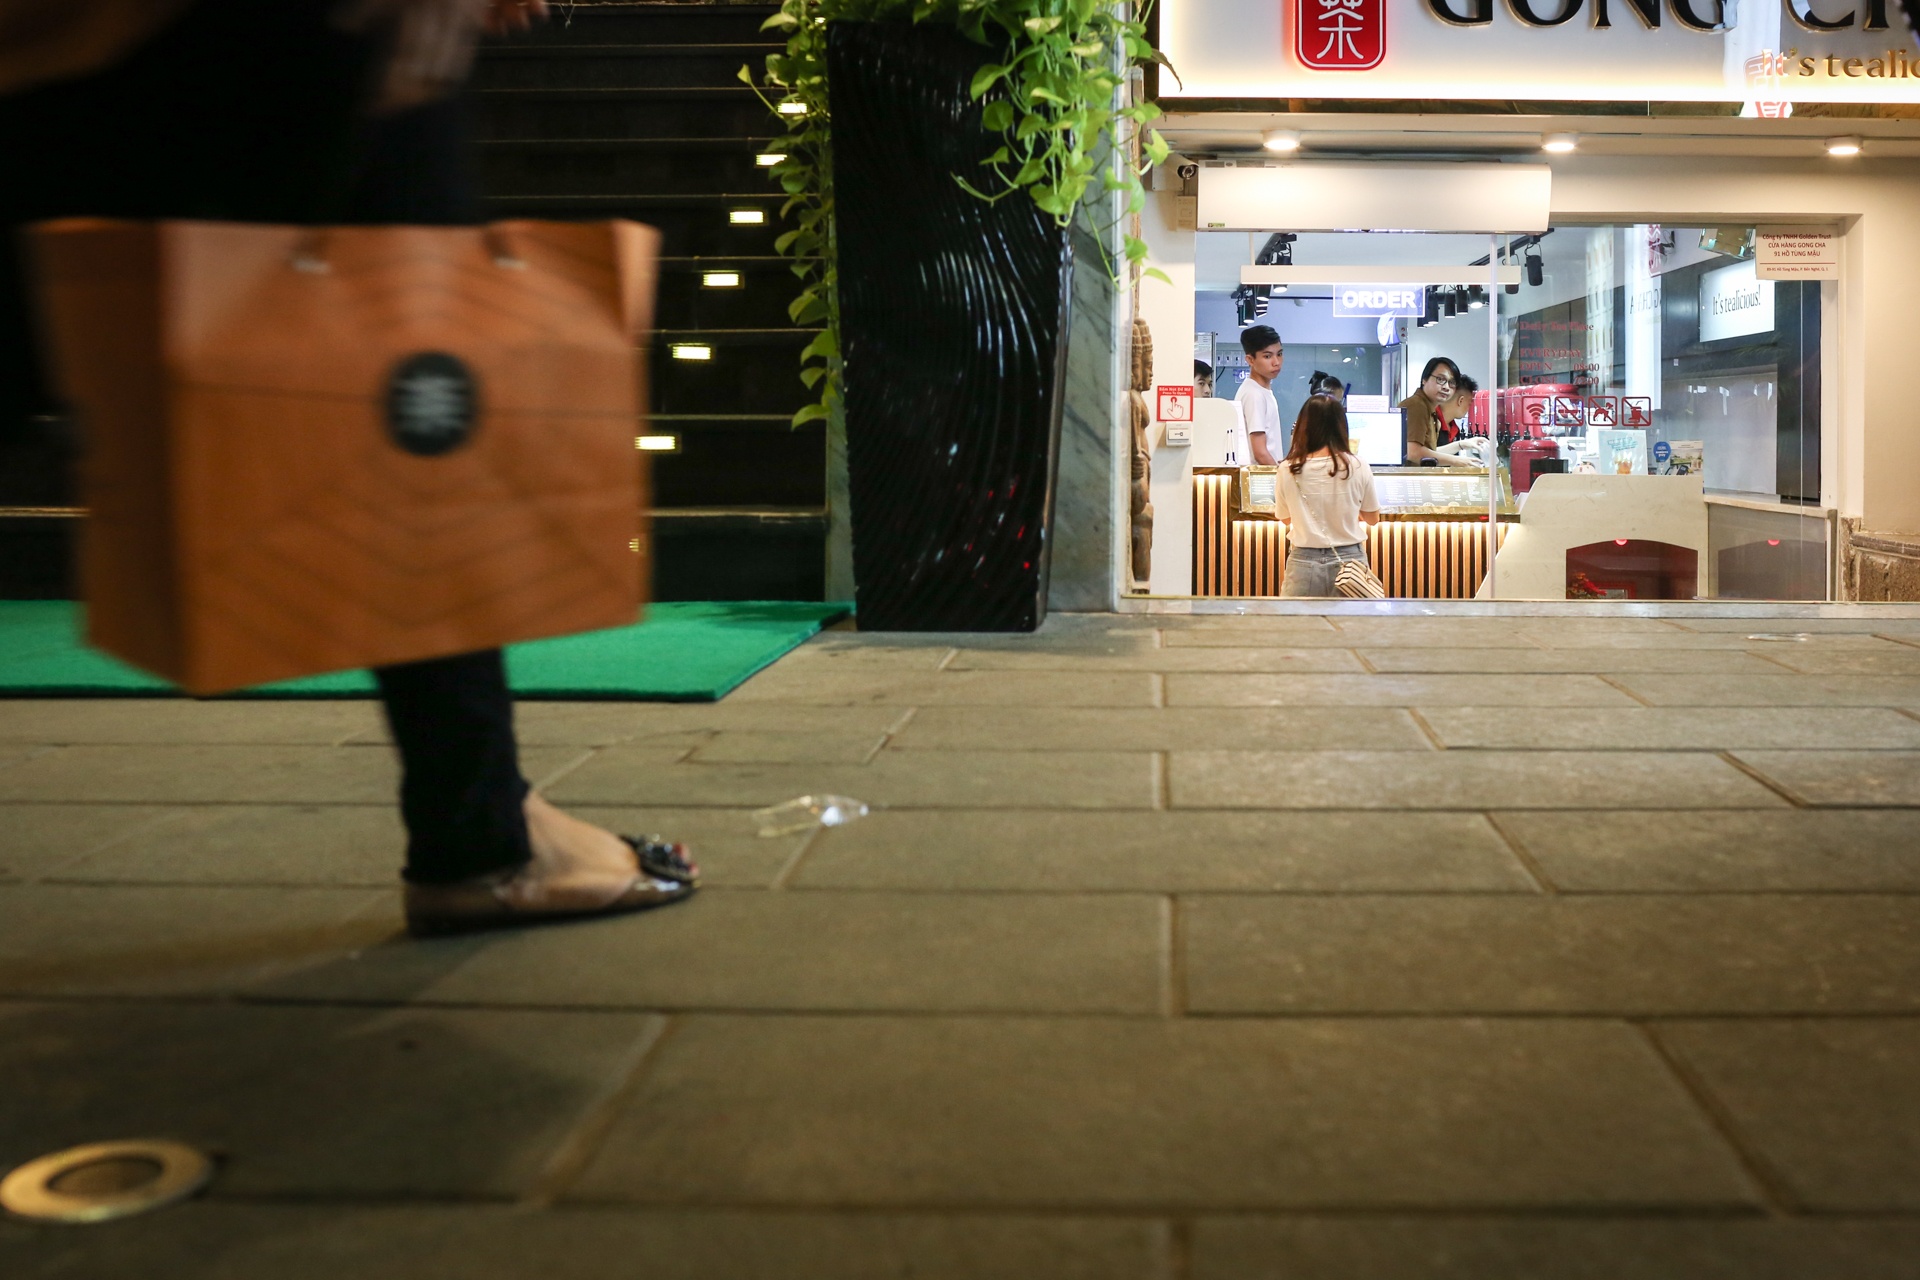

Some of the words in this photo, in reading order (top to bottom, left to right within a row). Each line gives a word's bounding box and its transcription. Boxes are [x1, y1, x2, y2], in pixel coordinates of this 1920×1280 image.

[1781, 249, 1790, 257] HỒ
[1807, 249, 1821, 258] MẬU
[1342, 290, 1417, 309] ORDER
[1713, 292, 1724, 315] It's
[1725, 284, 1761, 313] tealicious!
[1520, 348, 1583, 358] EVERYDAY
[1520, 362, 1553, 371] OPEN
[1520, 376, 1558, 385] CLOSE
